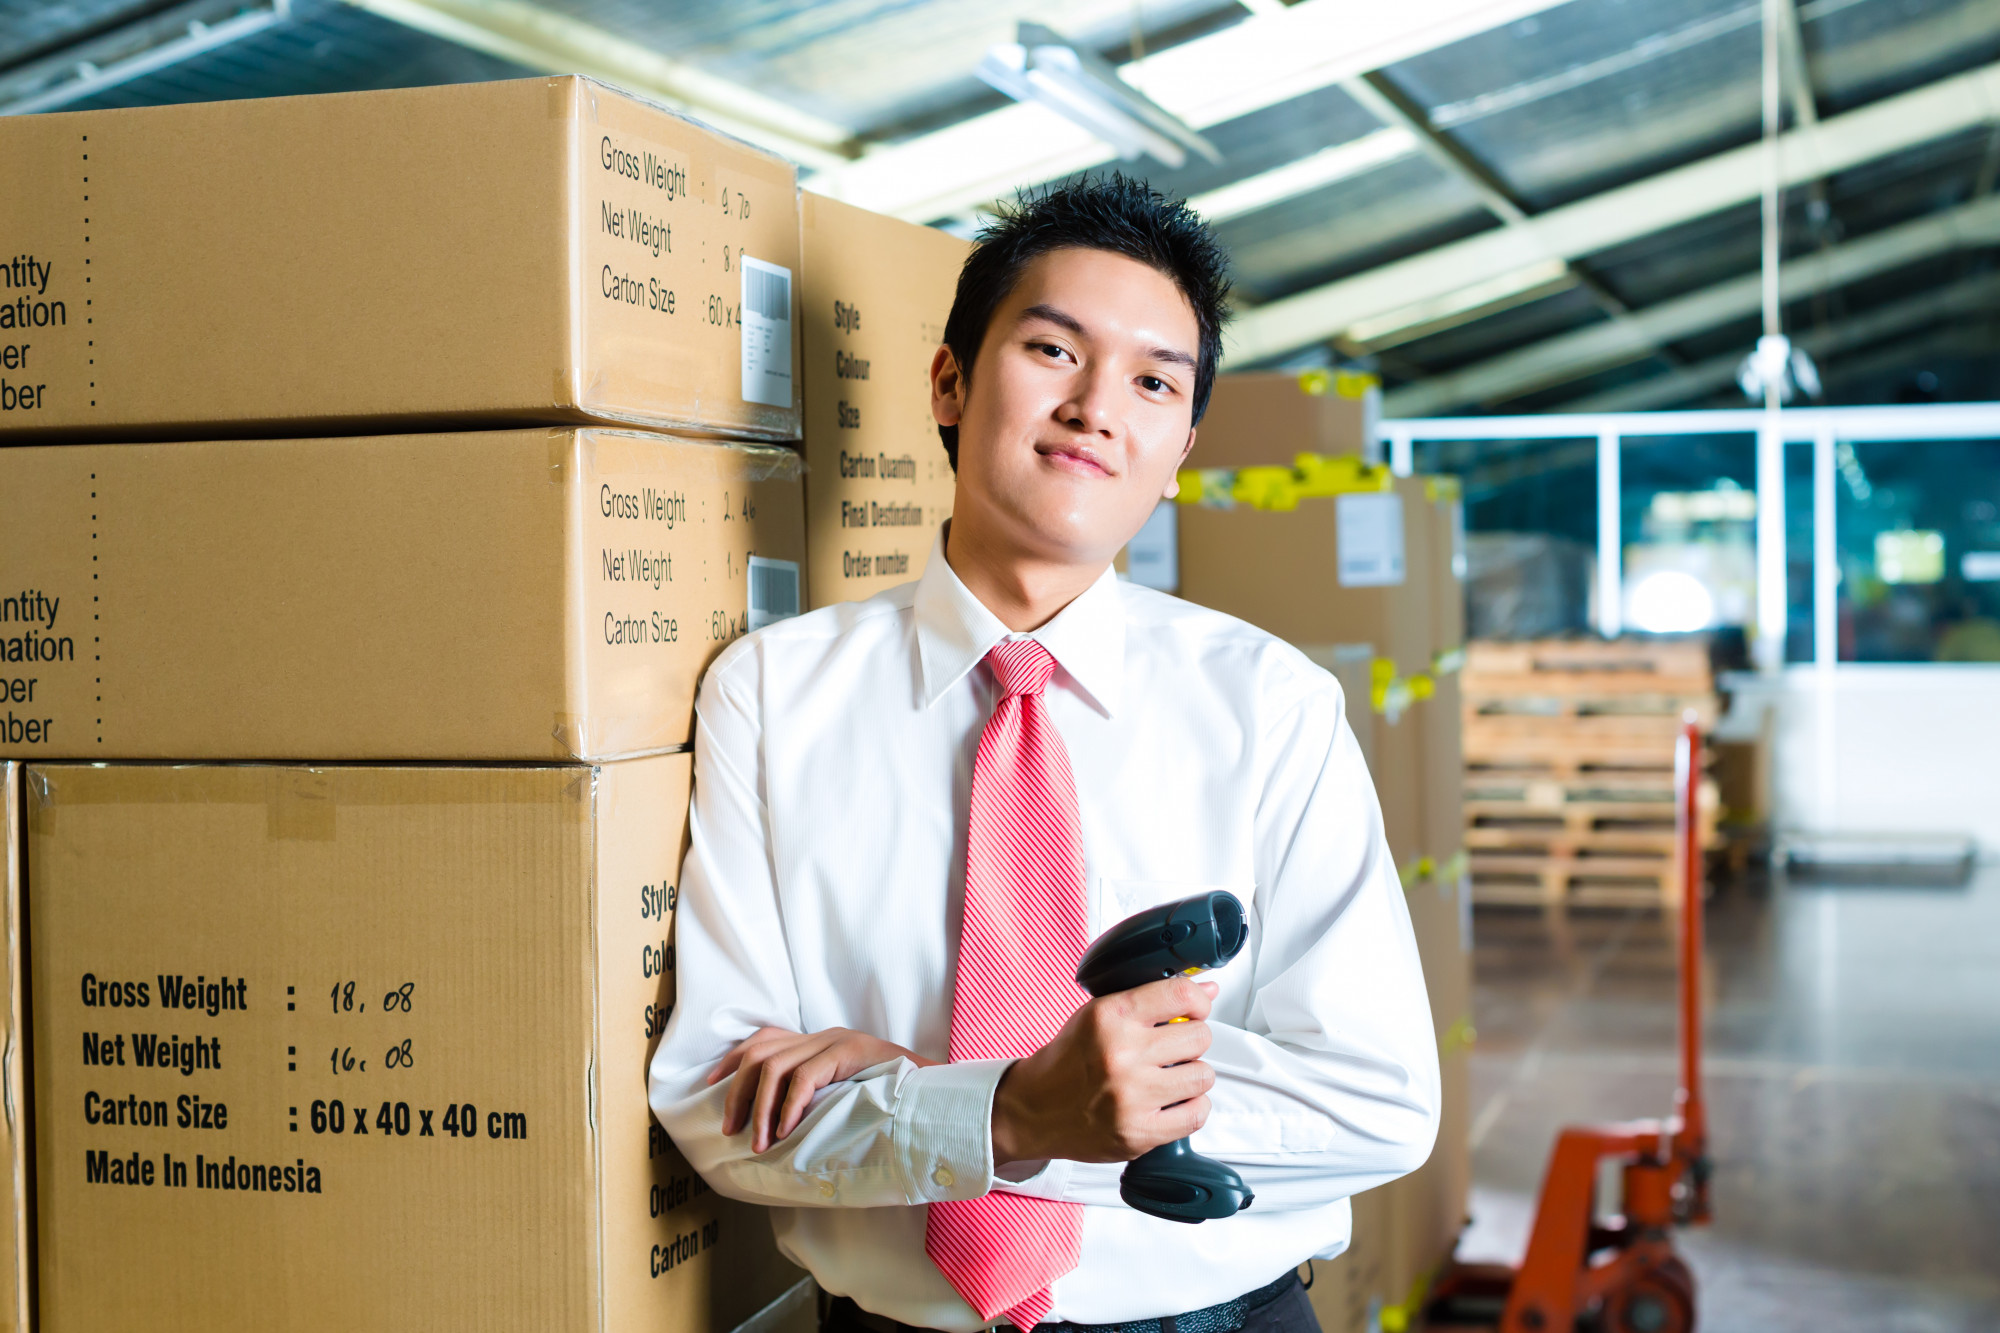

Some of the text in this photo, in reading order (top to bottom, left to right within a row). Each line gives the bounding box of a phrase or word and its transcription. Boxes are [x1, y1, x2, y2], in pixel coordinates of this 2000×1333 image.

[601, 136, 640, 181] Gross
[643, 151, 686, 202] Weight
[601, 200, 625, 239] Net
[628, 208, 672, 258] Weight
[0, 294, 66, 329] ation
[601, 264, 645, 307] Carton
[649, 277, 676, 315] Size
[708, 294, 722, 327] 60
[726, 306, 733, 329] x
[734, 303, 742, 331] 4
[834, 300, 860, 335] Style
[0, 344, 30, 369] er
[836, 350, 870, 381] Colour
[1, 377, 46, 411] ber
[838, 401, 860, 429] Size
[840, 450, 876, 479] Carton
[879, 452, 916, 485] Quantity
[600, 483, 639, 520] Gross
[642, 488, 686, 530] Weight
[842, 501, 868, 528] Final
[872, 501, 922, 527] Destination
[602, 548, 625, 582] Net
[628, 549, 673, 590] Weight
[843, 550, 909, 578] Order number
[0, 588, 59, 630] ntity
[604, 611, 647, 645] Carton
[651, 611, 678, 643] Size
[712, 610, 727, 641] 60
[730, 618, 737, 640] x
[739, 609, 748, 635] 4
[641, 880, 675, 922] Style
[643, 940, 676, 979] Colo
[81, 973, 150, 1008] Gross
[157, 974, 248, 1017] Weight
[82, 1032, 125, 1066] Net
[132, 1033, 221, 1076] Weight
[84, 1091, 168, 1127] Carton
[176, 1095, 228, 1130] Size
[310, 1099, 345, 1135] 60
[353, 1107, 369, 1136] x
[375, 1101, 411, 1137] 40
[419, 1109, 434, 1137] x
[442, 1104, 478, 1138] 40
[487, 1111, 527, 1140] cm
[649, 1125, 676, 1159] Fin
[86, 1150, 322, 1194] Made In Indonesia
[650, 1176, 689, 1218] Order
[650, 1218, 718, 1279] Carton no
